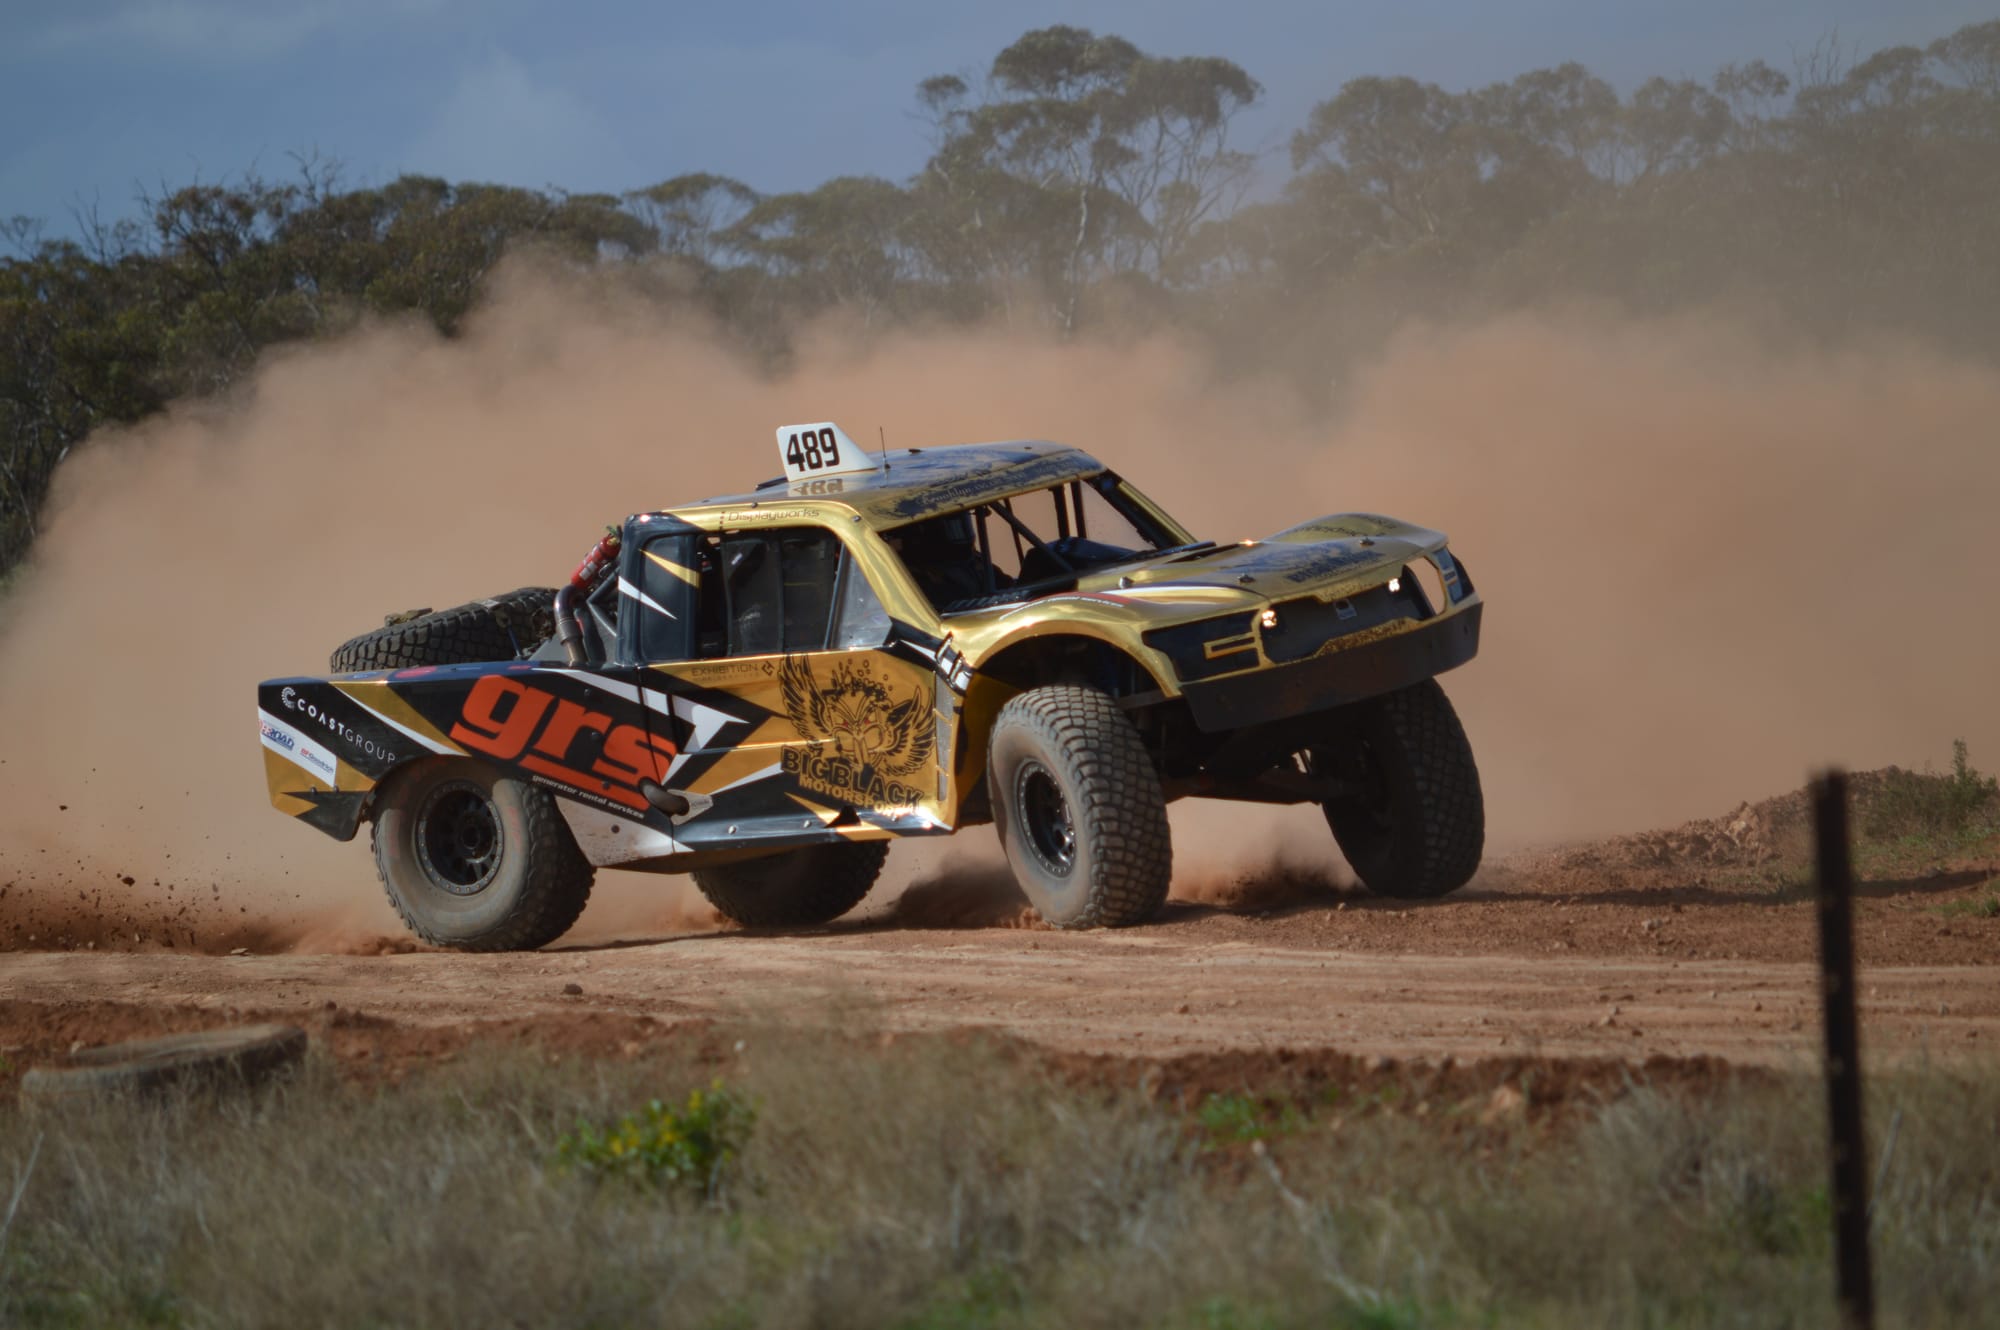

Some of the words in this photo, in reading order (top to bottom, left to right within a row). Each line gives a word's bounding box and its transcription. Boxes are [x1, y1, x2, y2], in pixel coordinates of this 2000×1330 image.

[786, 427, 840, 472] 489
[728, 509, 820, 523] Displayworks
[449, 674, 678, 789] grs
[532, 775, 578, 795] generator
[578, 790, 608, 806] rental
[607, 800, 645, 819] services
[799, 776, 907, 817] MOTORSPOR
